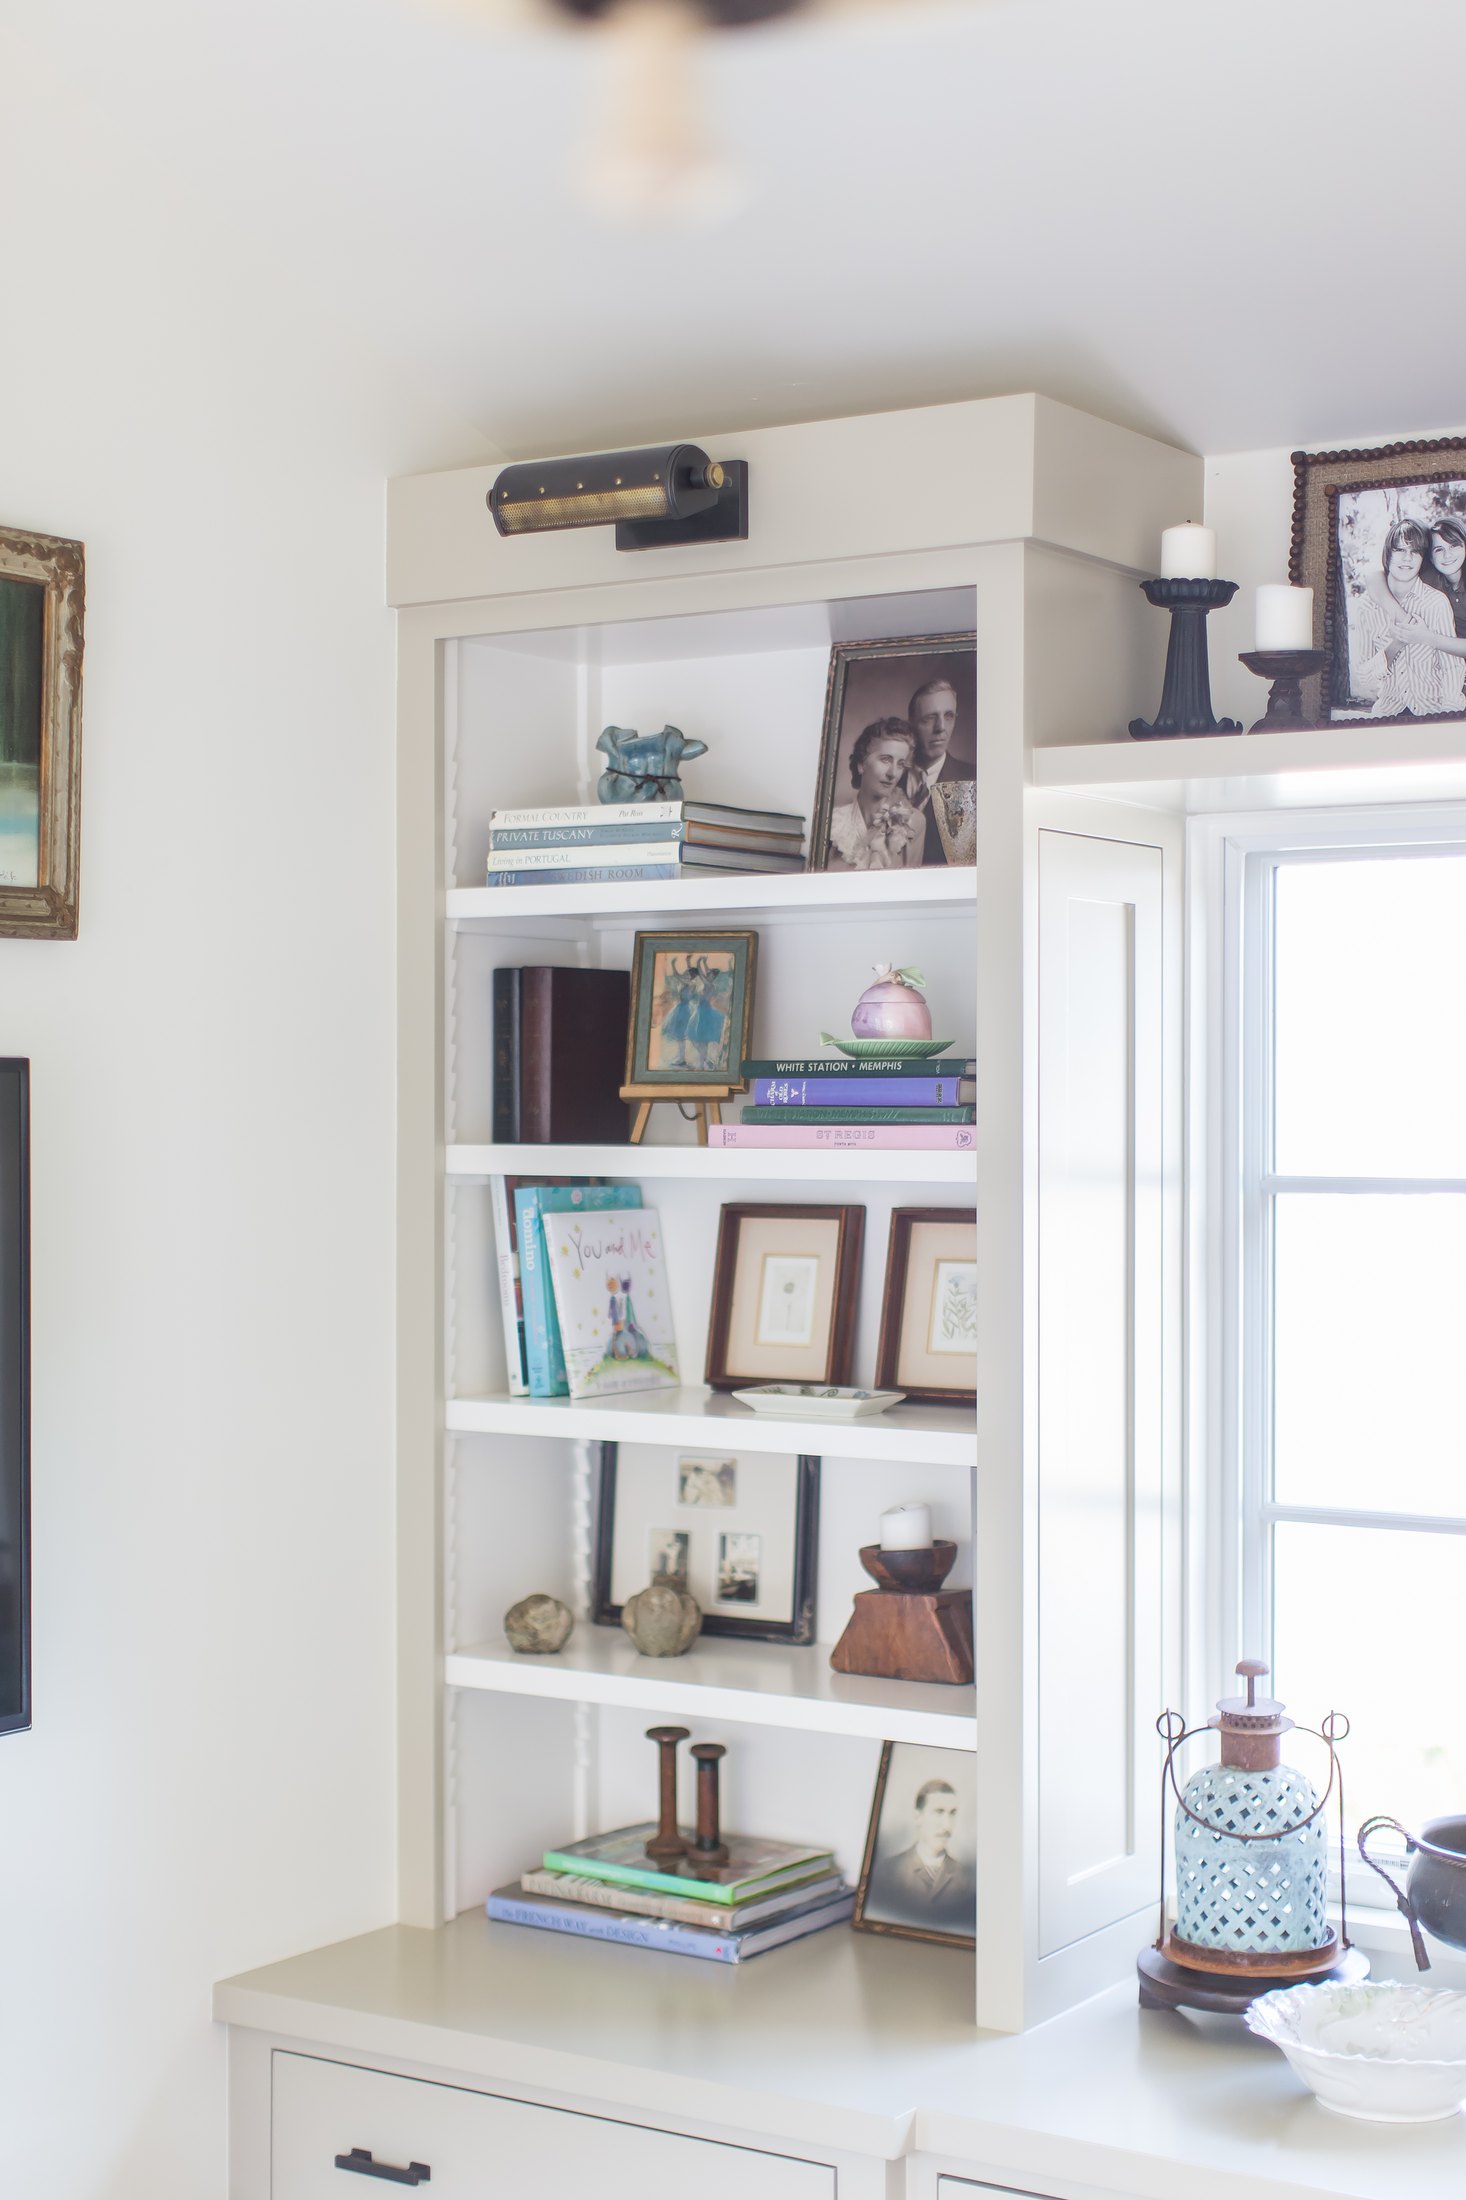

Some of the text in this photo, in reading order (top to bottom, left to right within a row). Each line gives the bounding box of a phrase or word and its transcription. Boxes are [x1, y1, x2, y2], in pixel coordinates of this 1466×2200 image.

[503, 811, 587, 824] FORMAL COUNTRY
[496, 830, 540, 842] PRIVATE
[542, 829, 594, 840] TUSCANY
[524, 854, 571, 864] PORTUGAL
[608, 867, 644, 880] ROOM
[776, 1061, 902, 1073] WHITE STATION MEMPHIS
[834, 1130, 876, 1140] REGIS
[522, 1207, 537, 1271] domino
[629, 1228, 656, 1262] Me
[514, 1908, 560, 1929] FRENCH
[562, 1918, 588, 1933] WAY
[605, 1926, 650, 1944] DESIGN
